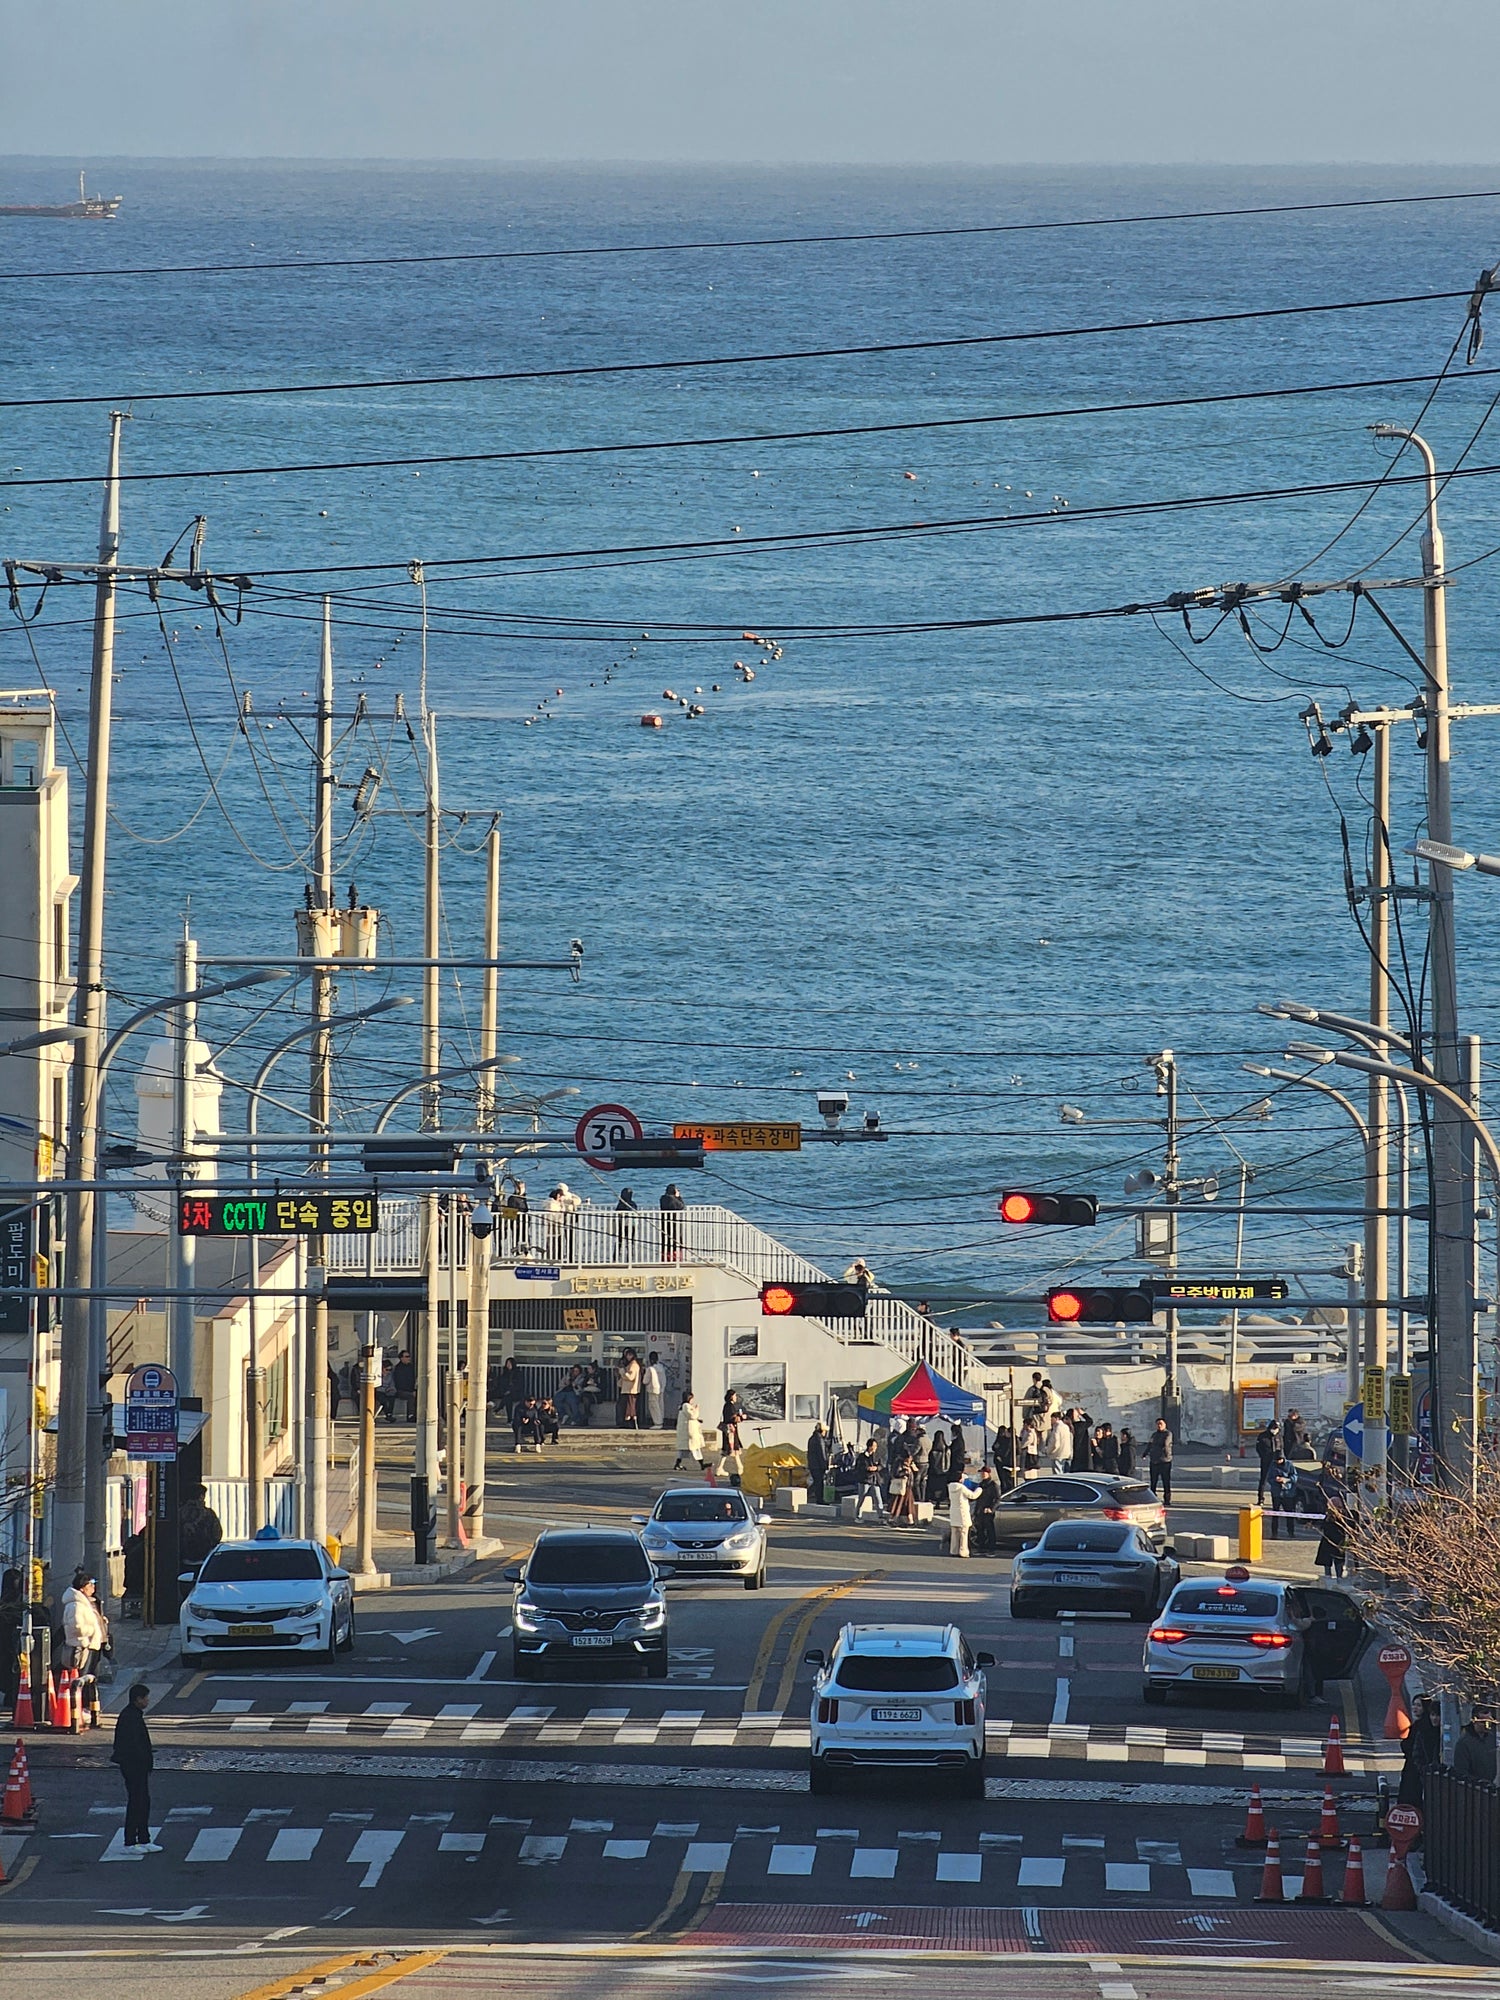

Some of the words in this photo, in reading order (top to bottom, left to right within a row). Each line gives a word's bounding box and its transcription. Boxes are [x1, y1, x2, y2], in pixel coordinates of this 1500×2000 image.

[223, 1202, 268, 1231] CCTV
[276, 1201, 319, 1229] 단속
[331, 1200, 372, 1229] 중입
[593, 1276, 647, 1293] 푸른모래
[900, 1711, 919, 1719] 6623
